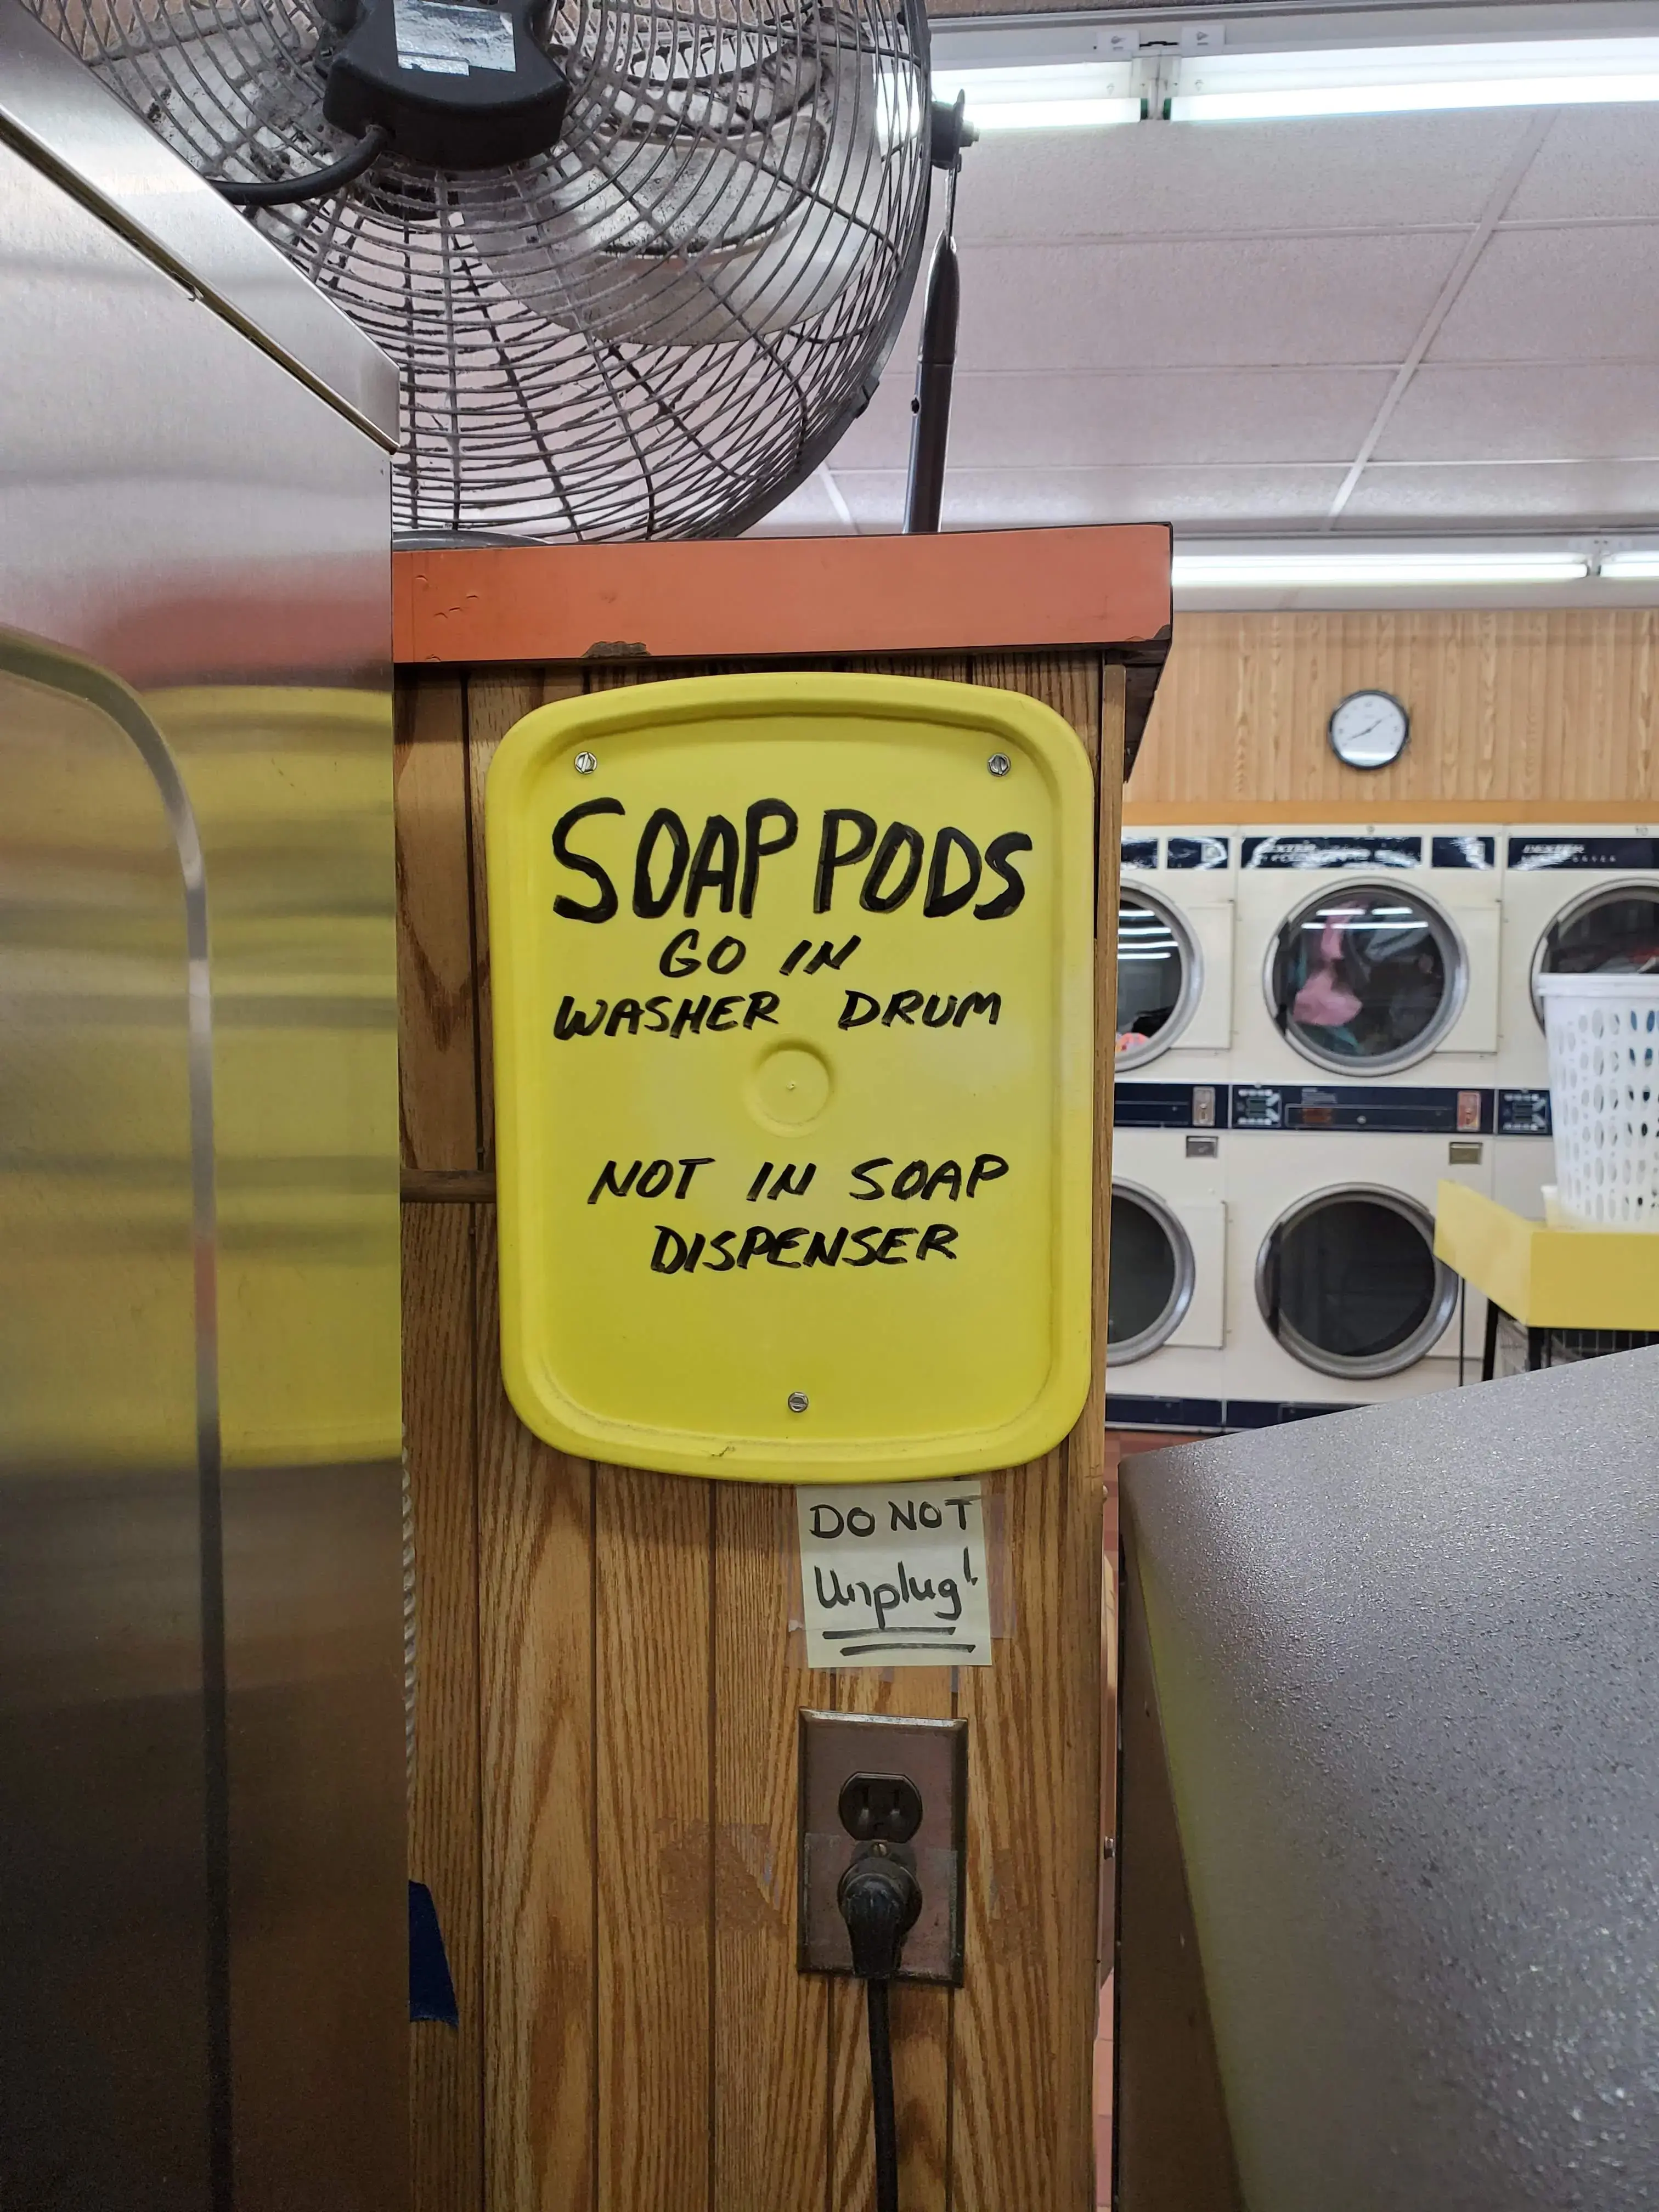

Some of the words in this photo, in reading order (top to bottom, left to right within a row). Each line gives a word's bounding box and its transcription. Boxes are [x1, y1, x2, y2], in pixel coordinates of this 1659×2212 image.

[551, 797, 799, 924] SOAP
[812, 808, 1034, 921] PODS
[659, 928, 746, 978] GO
[778, 934, 862, 977] IN
[553, 990, 780, 1041] WASHER
[837, 989, 1002, 1031] DRUM
[587, 1156, 716, 1205] NOT
[746, 1161, 817, 1202] IN
[849, 1153, 1009, 1201] SOAP
[650, 1223, 959, 1275] DISPENSER
[809, 1504, 876, 1539] DO
[887, 1494, 982, 1531] NOT
[814, 1546, 978, 1630] Unplug!
